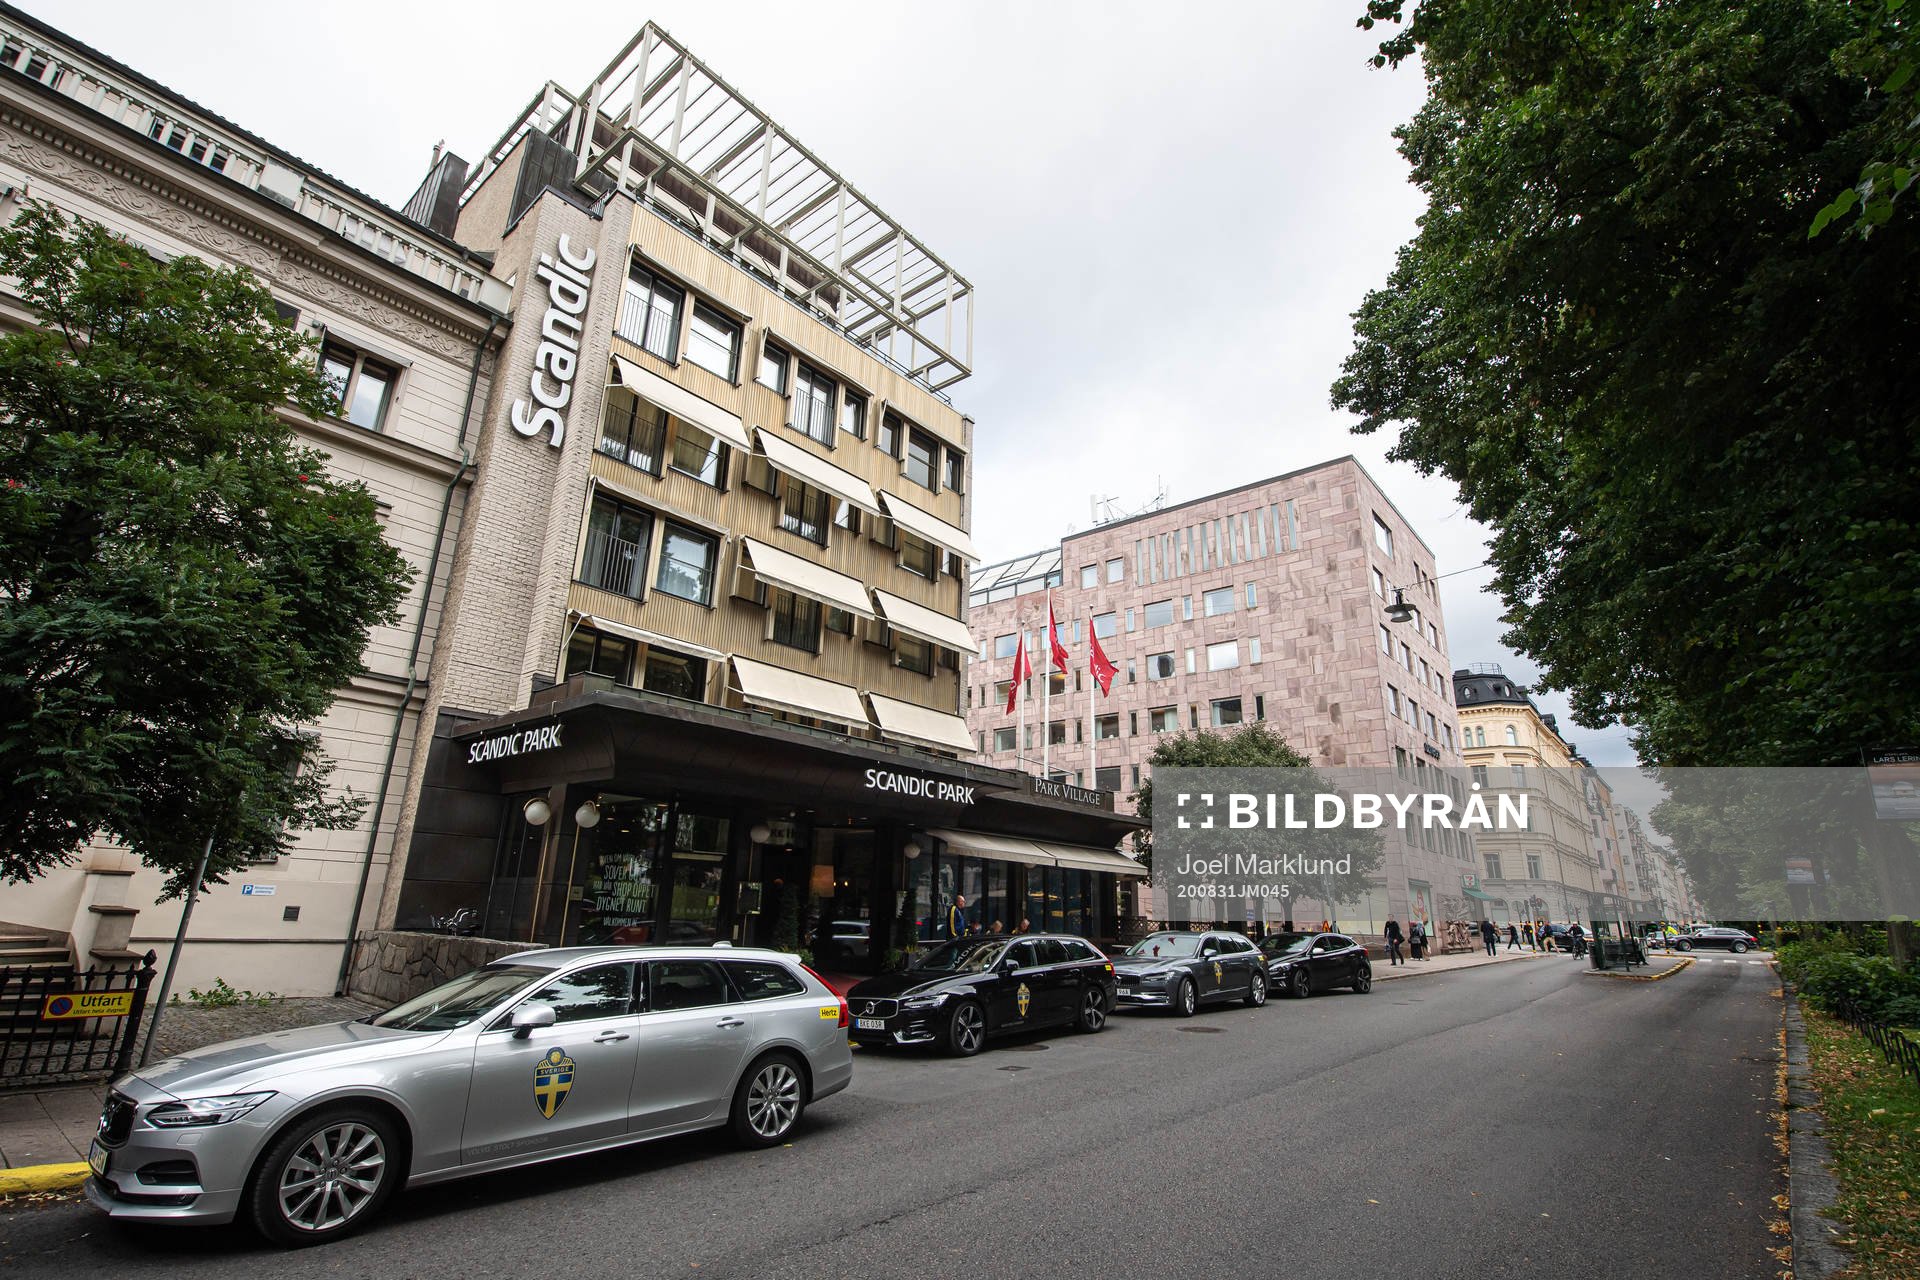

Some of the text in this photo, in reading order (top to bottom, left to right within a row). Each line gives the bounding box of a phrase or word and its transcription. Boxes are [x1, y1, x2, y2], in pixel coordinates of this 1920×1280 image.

[511, 233, 596, 448] Scandic
[467, 723, 561, 764] SCANDIC PARK
[865, 768, 975, 805] SCANDIC PARK
[1034, 778, 1101, 806] PARK VILLAGE
[612, 881, 632, 897] SHOP
[596, 896, 648, 913] DYGNET RUNT
[81, 995, 122, 1007] Utfart
[821, 1009, 837, 1017] Hertz
[540, 1066, 569, 1075] SVERIGE
